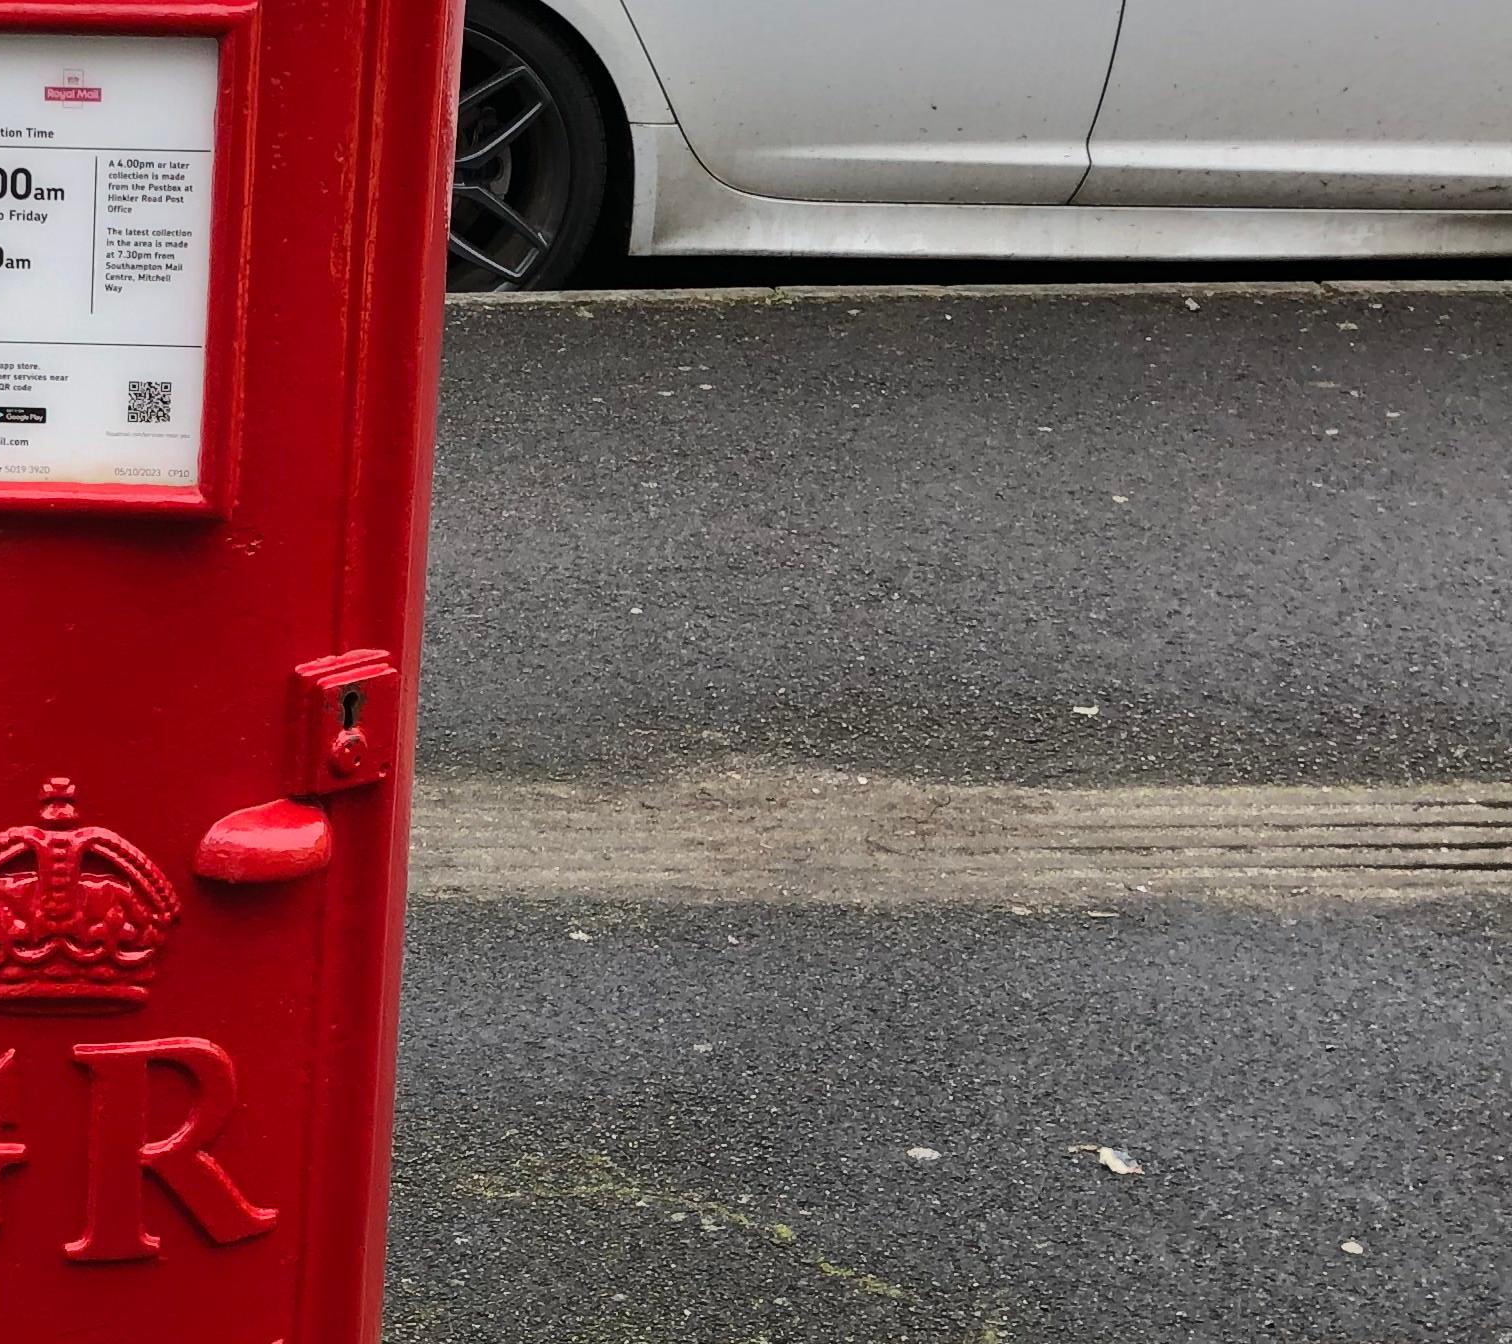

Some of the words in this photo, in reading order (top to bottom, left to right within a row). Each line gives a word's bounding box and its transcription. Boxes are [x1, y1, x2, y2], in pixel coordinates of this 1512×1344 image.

[48, 88, 74, 100] Royal
[77, 89, 100, 99] Mail
[26, 128, 54, 138] Time
[118, 159, 154, 170] 4.00pm
[170, 161, 190, 169] later
[108, 172, 148, 180] collection
[152, 172, 158, 180] is
[108, 182, 128, 190] from
[148, 184, 181, 192] Postbox
[108, 194, 138, 202] Hinkler
[166, 195, 184, 203] Post
[108, 205, 132, 213] Office
[9, 210, 48, 224] Friday
[126, 228, 149, 236] latest
[152, 229, 192, 237] collection
[118, 250, 152, 260] 7.30pm
[106, 262, 162, 271] Southampton
[106, 273, 135, 281] Centre,
[105, 284, 122, 293] Way
[13, 373, 47, 381] services
